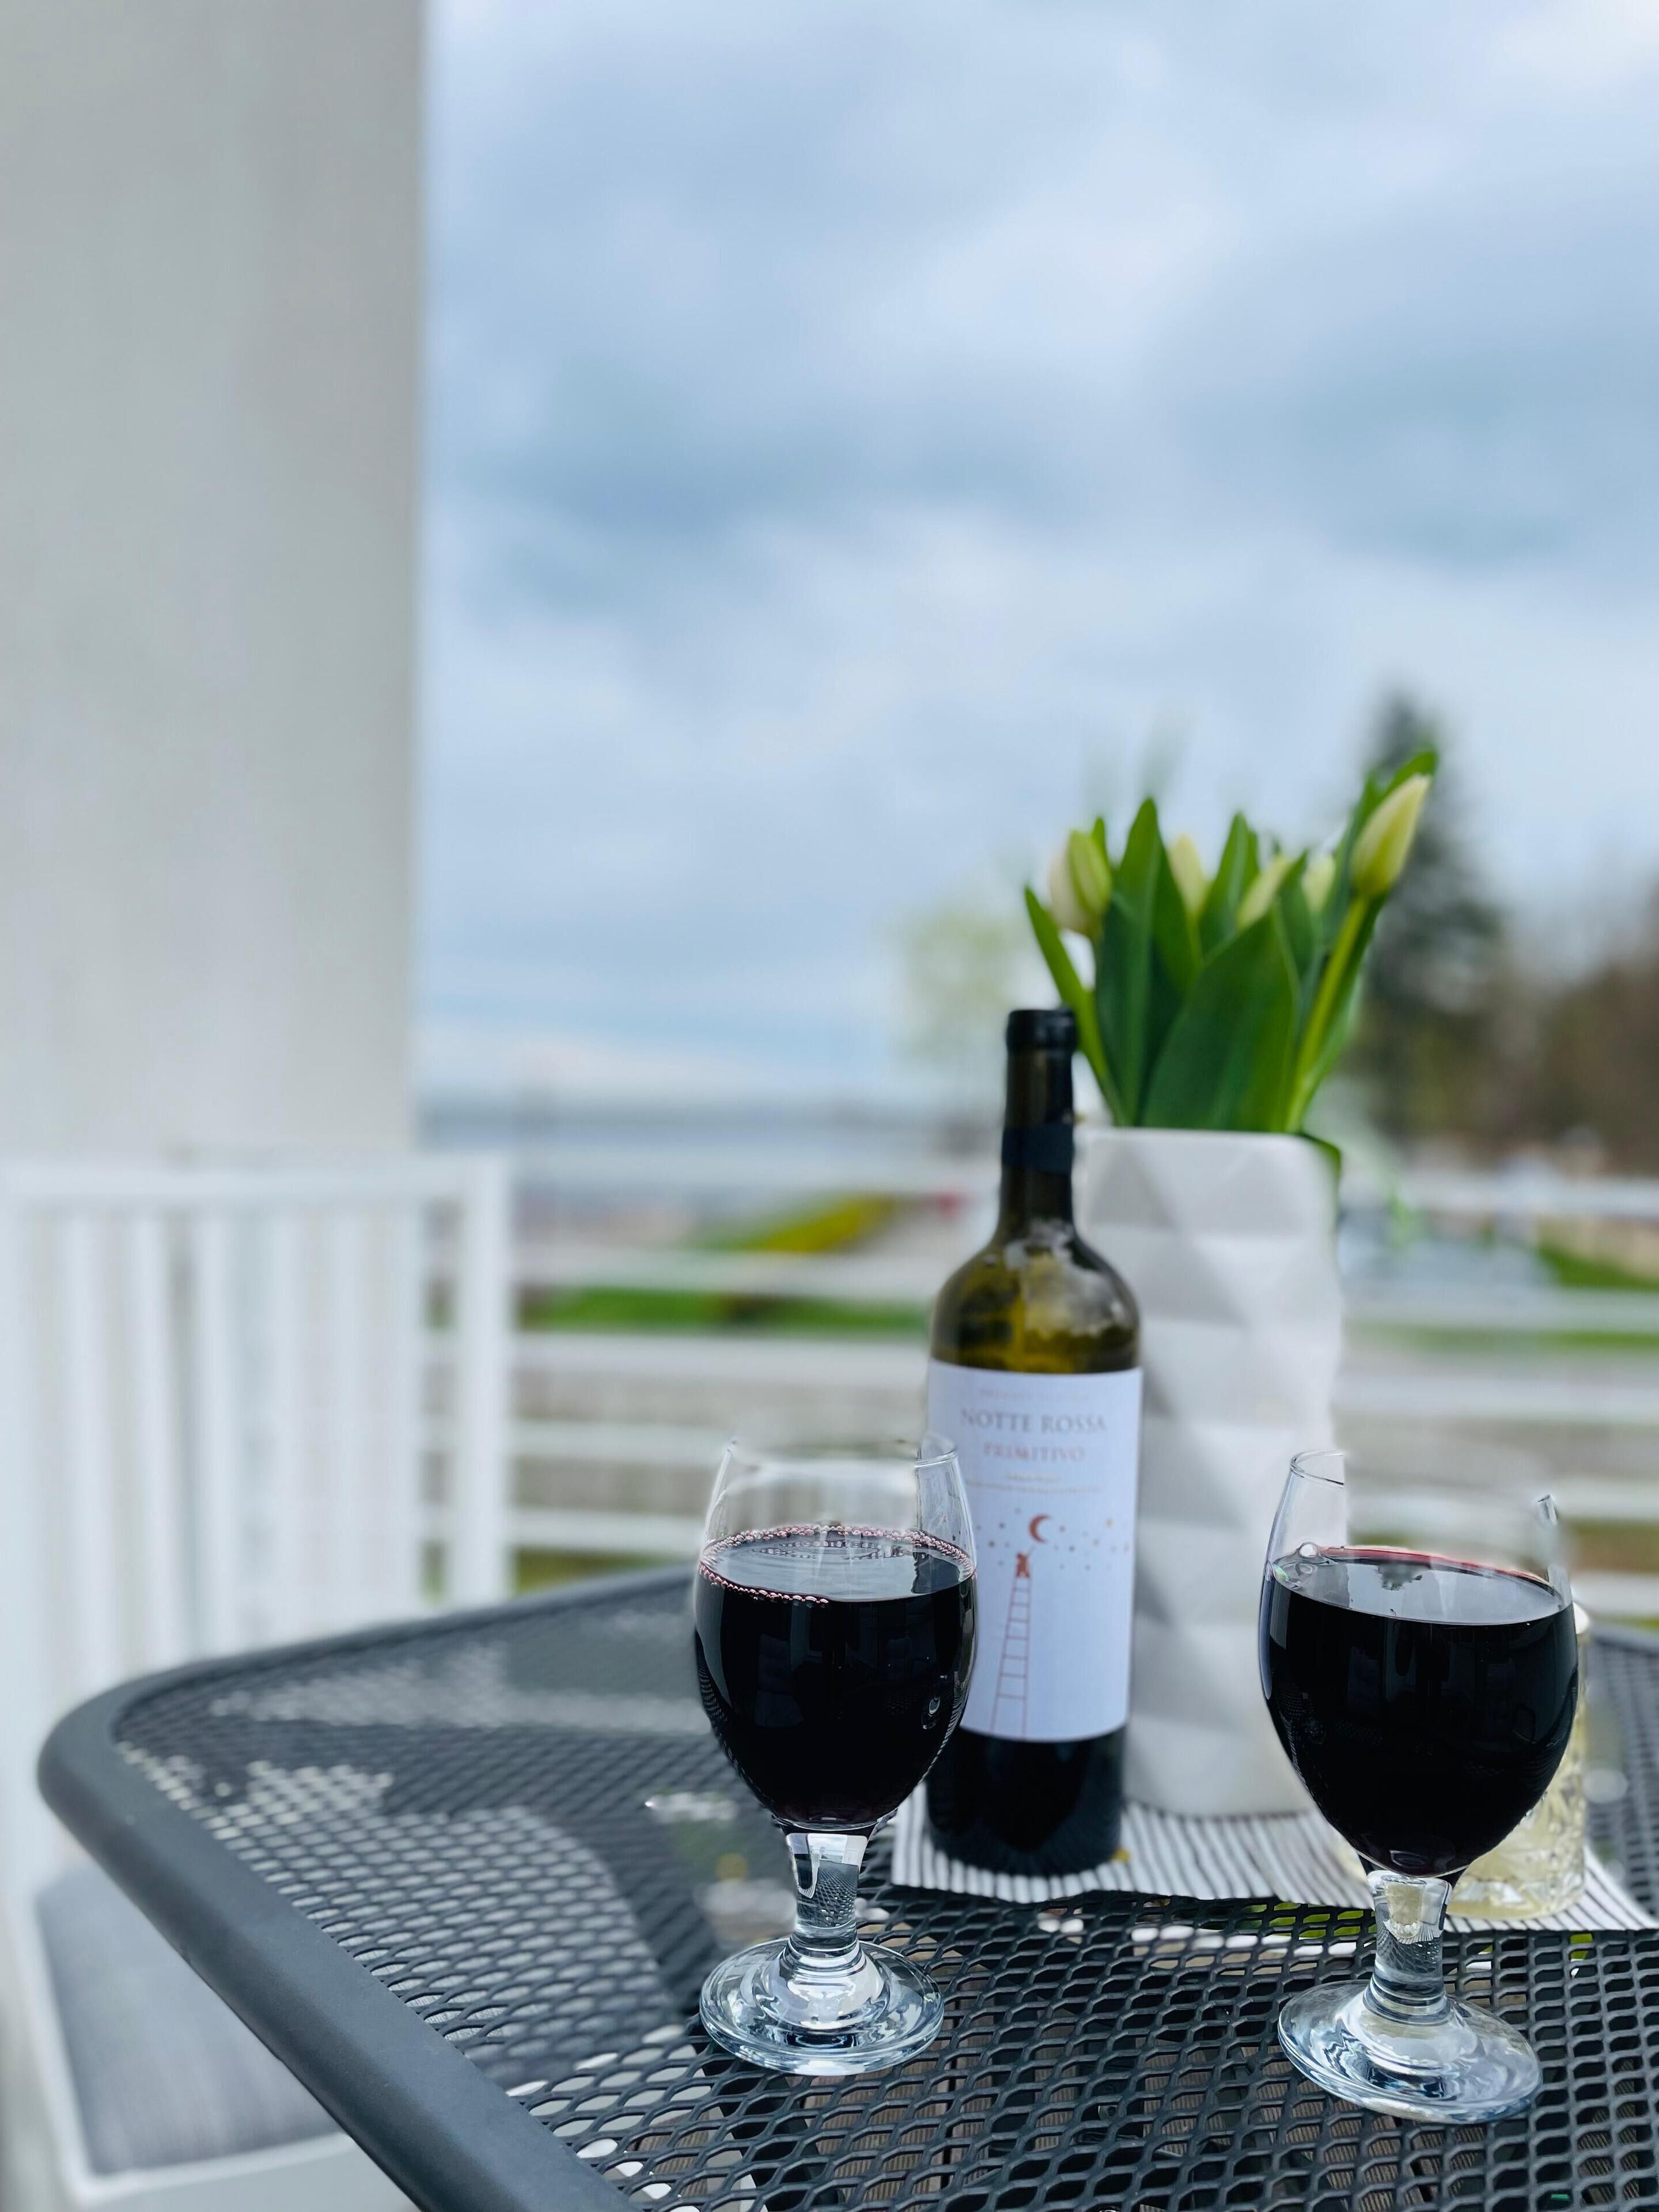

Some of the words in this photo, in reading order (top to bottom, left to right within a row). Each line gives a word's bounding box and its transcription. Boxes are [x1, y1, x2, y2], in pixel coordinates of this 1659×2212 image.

[961, 1408, 1032, 1433] NOTTE
[1040, 1414, 1107, 1434] ROSSA
[983, 1442, 1086, 1463] PRIMITIVO
